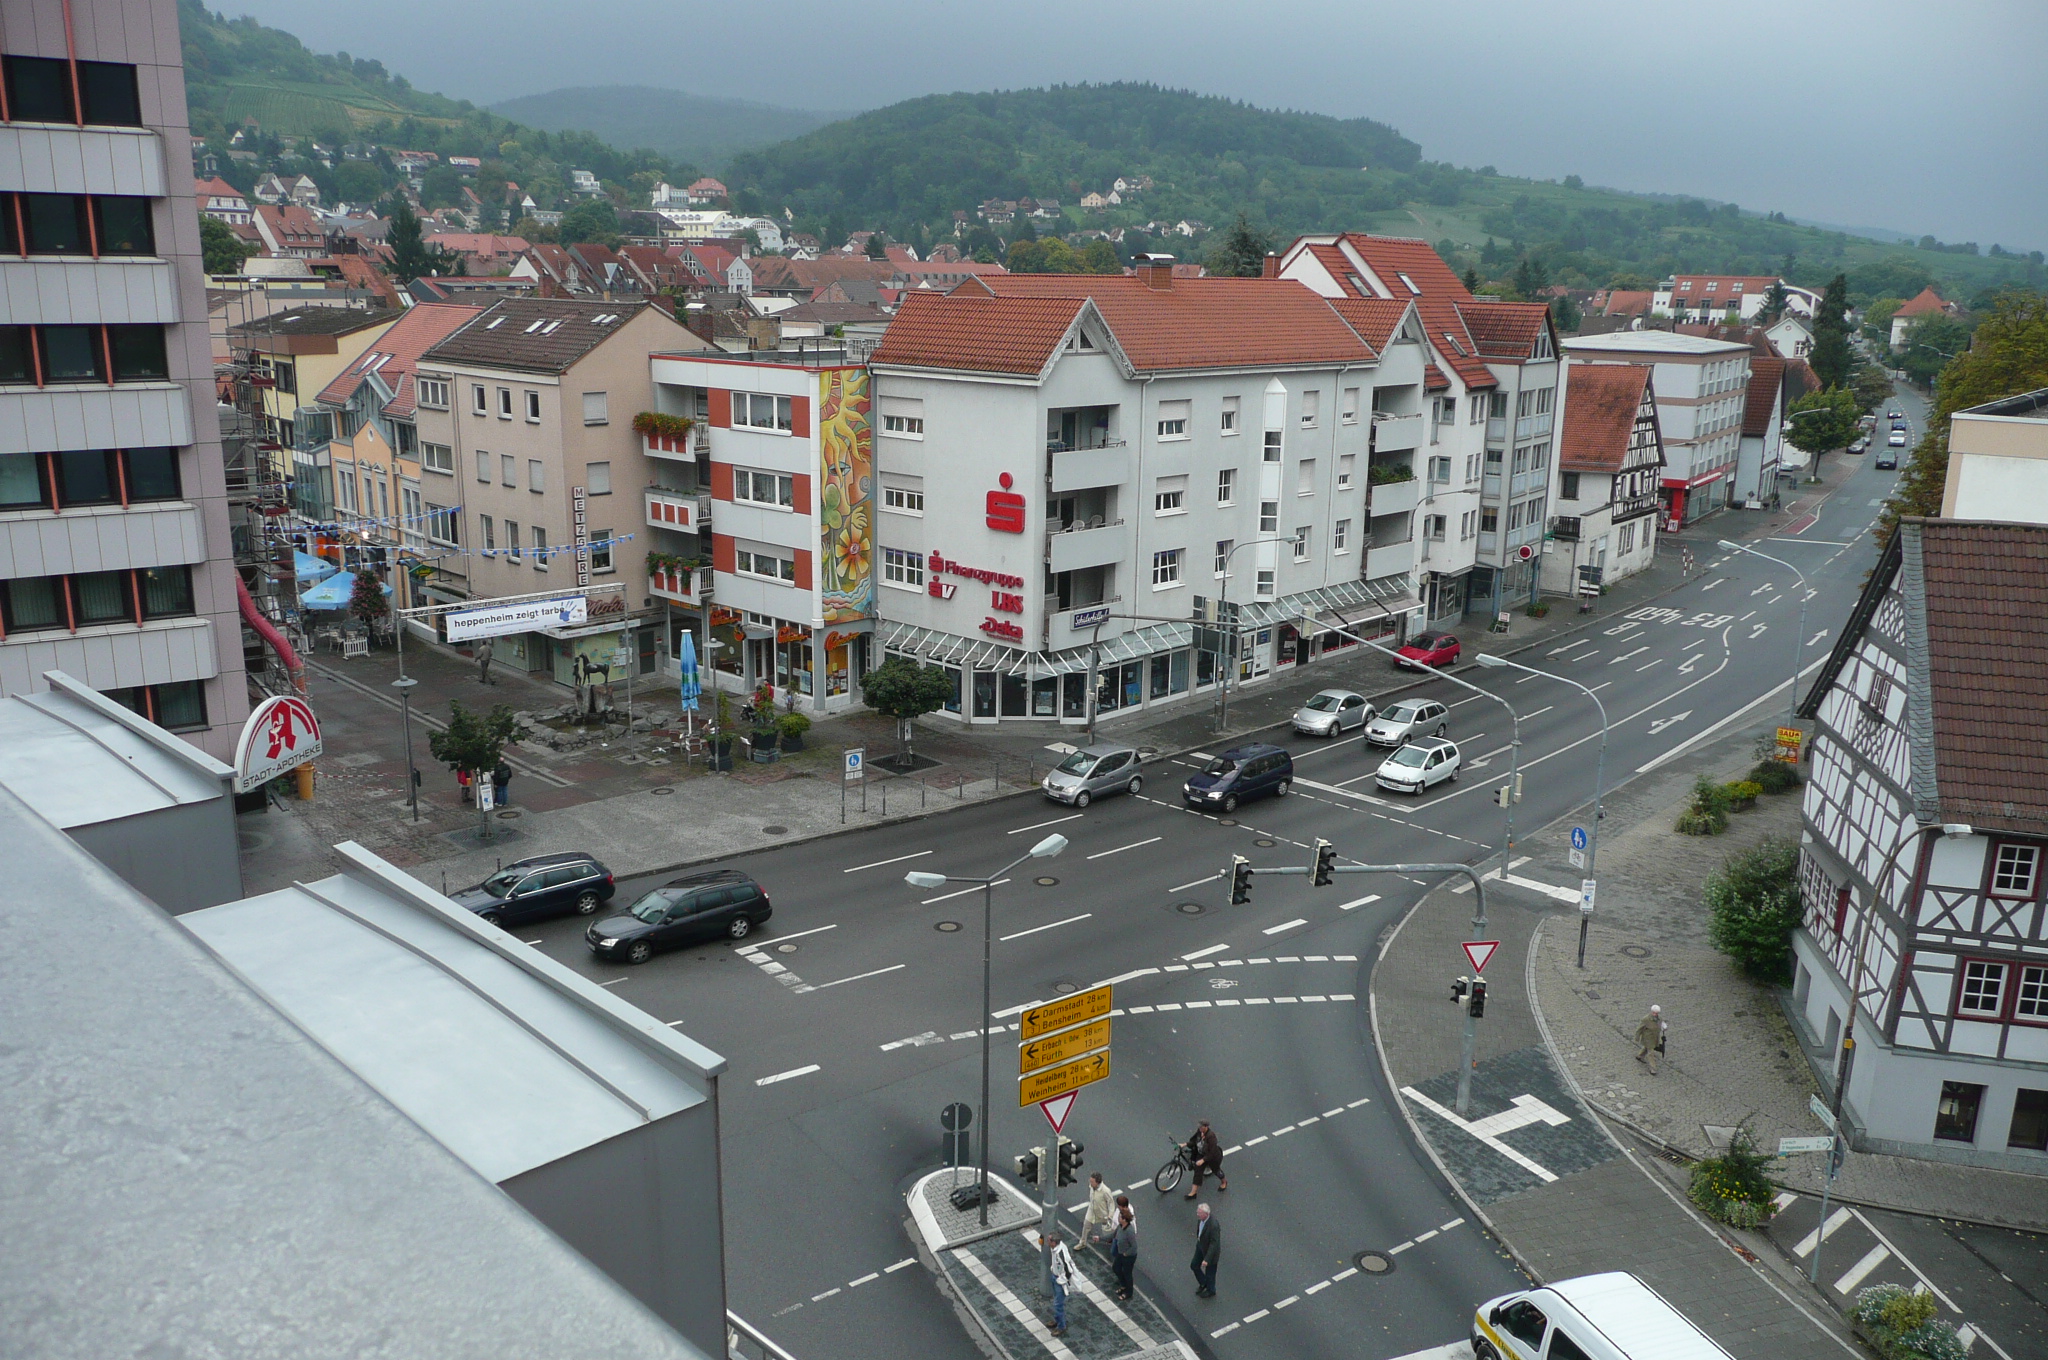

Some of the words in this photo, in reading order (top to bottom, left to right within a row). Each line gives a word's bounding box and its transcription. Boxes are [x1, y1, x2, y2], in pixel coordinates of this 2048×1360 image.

[575, 488, 587, 584] METZGERE
[945, 559, 1024, 589] Finanzgruppe
[991, 590, 1024, 615] LBS
[454, 613, 514, 629] heppenheim
[516, 609, 539, 621] zeigt
[541, 606, 565, 616] farbe
[979, 616, 1024, 639] Deka
[243, 743, 321, 788] STADT-APOTHEKE
[1042, 1000, 1084, 1018] Darmstadt
[1087, 994, 1096, 1004] 28
[1097, 993, 1107, 1001] km
[1042, 1012, 1082, 1030] Bensheim
[1090, 1005, 1096, 1013] 4
[1042, 1040, 1062, 1052] Erbach
[1083, 1028, 1093, 1038] 38
[1085, 1039, 1093, 1048] 13
[1094, 1037, 1103, 1045] km
[1028, 1081, 1067, 1100] Weinheim
[1072, 1077, 1079, 1085] 11
[1080, 1074, 1090, 1082] km
[1035, 1070, 1067, 1087] Heidelberg
[1070, 1064, 1079, 1075] 28
[1080, 1063, 1090, 1071] km
